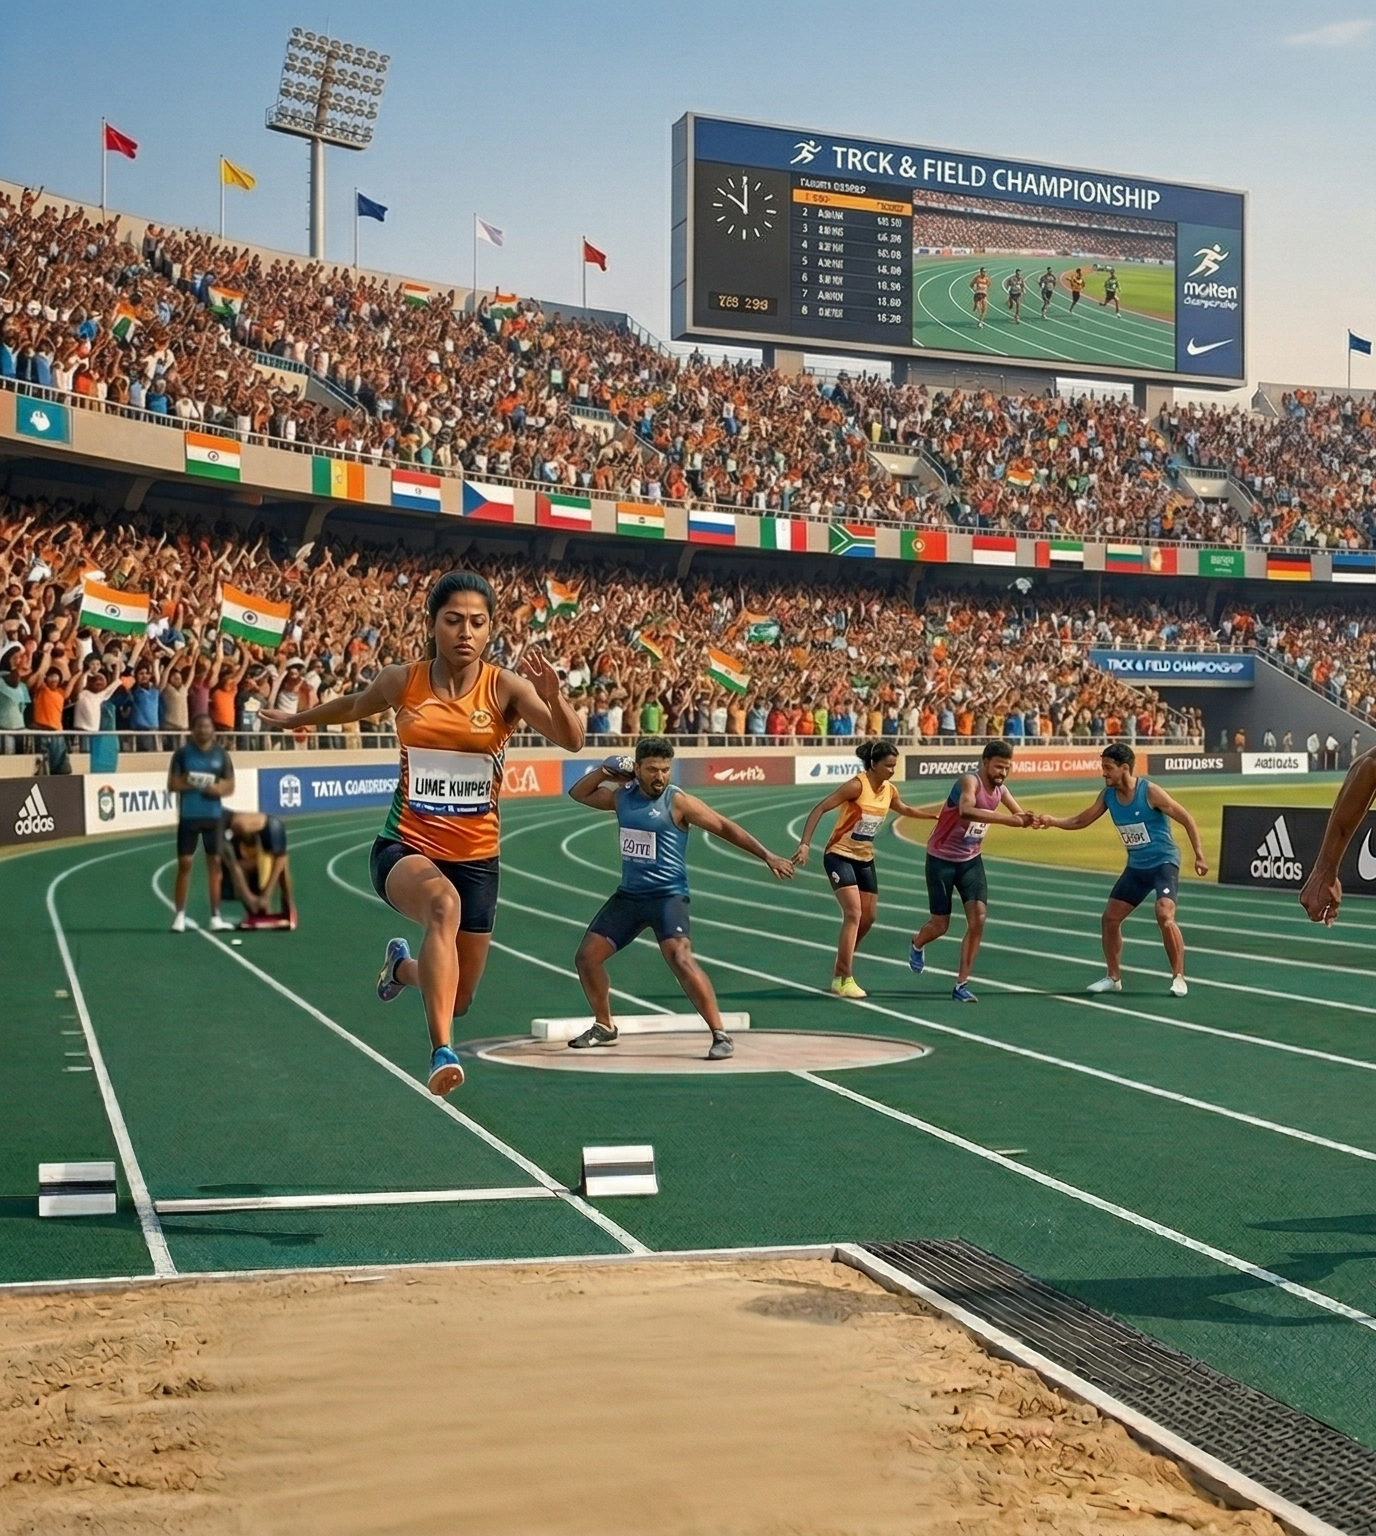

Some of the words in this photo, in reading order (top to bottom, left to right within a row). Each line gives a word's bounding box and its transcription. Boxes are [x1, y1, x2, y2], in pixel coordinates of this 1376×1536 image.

[832, 146, 894, 176] TRCK
[899, 156, 917, 179] &
[923, 158, 986, 188] FIELD
[992, 169, 1161, 210] CHAMPIONSHIP
[802, 207, 808, 217] 2
[802, 223, 808, 233] 3
[801, 240, 808, 249] 4
[802, 256, 808, 265] 5
[802, 272, 808, 282] 6
[802, 288, 808, 298] 7
[801, 305, 809, 315] 8
[311, 780, 343, 798] TATA
[119, 790, 160, 813] TATA
[1250, 855, 1303, 881] adidas
